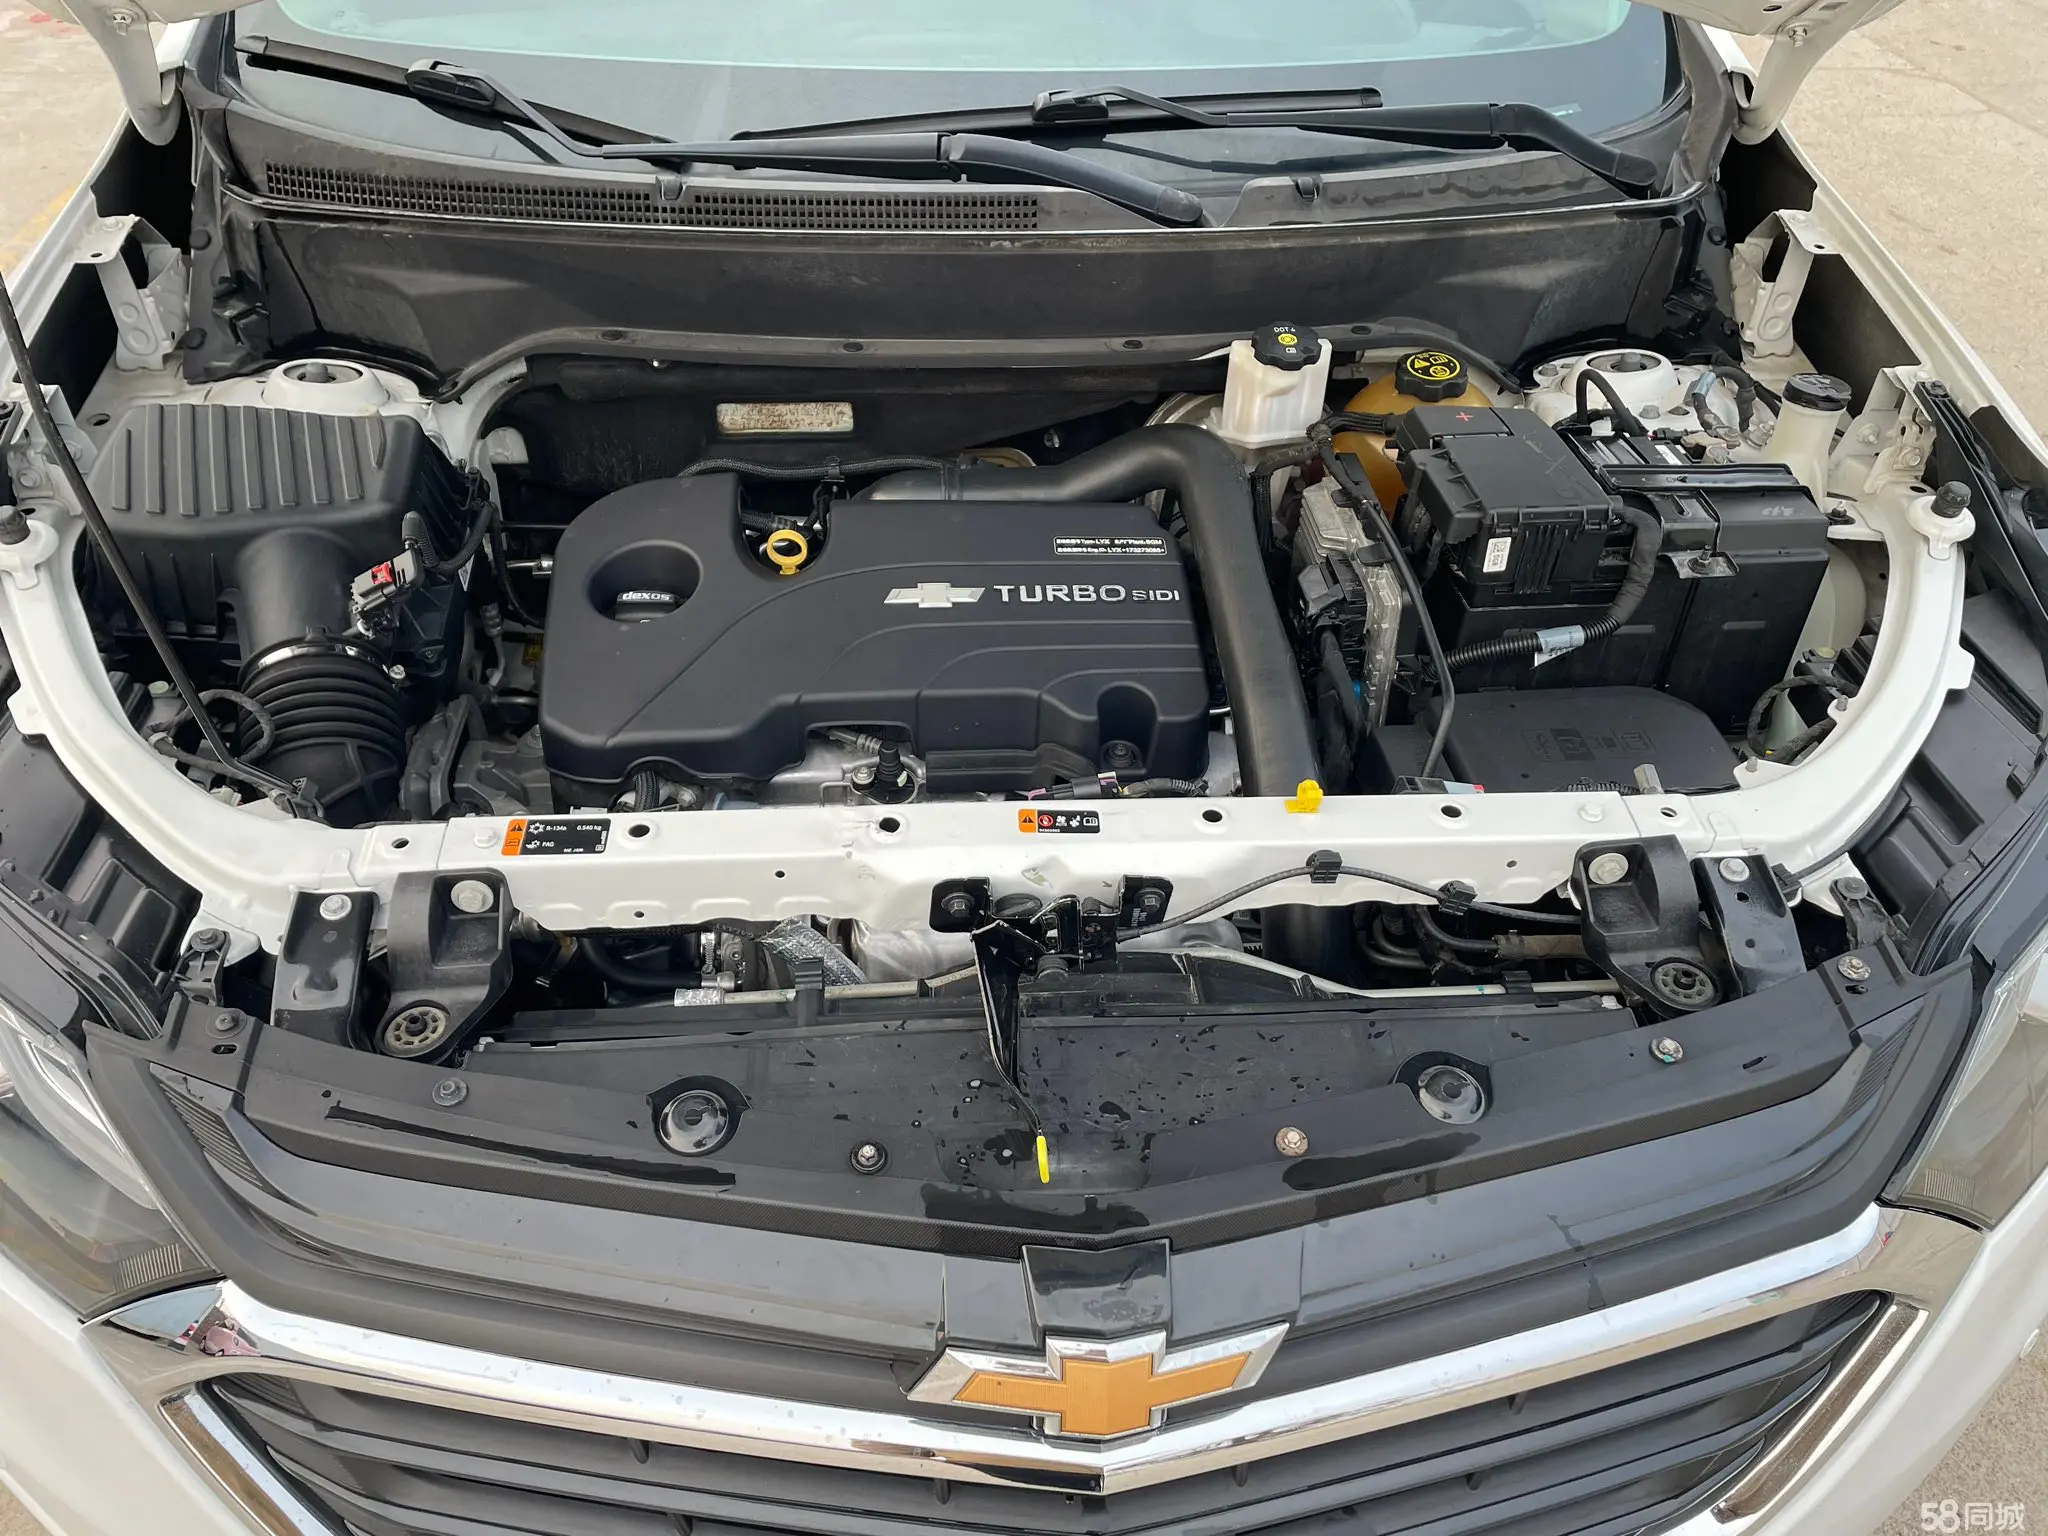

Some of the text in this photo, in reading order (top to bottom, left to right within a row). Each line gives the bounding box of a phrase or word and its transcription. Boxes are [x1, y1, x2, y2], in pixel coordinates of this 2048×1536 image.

[622, 591, 671, 601] dexos
[993, 584, 1180, 602] TURBO SIDI
